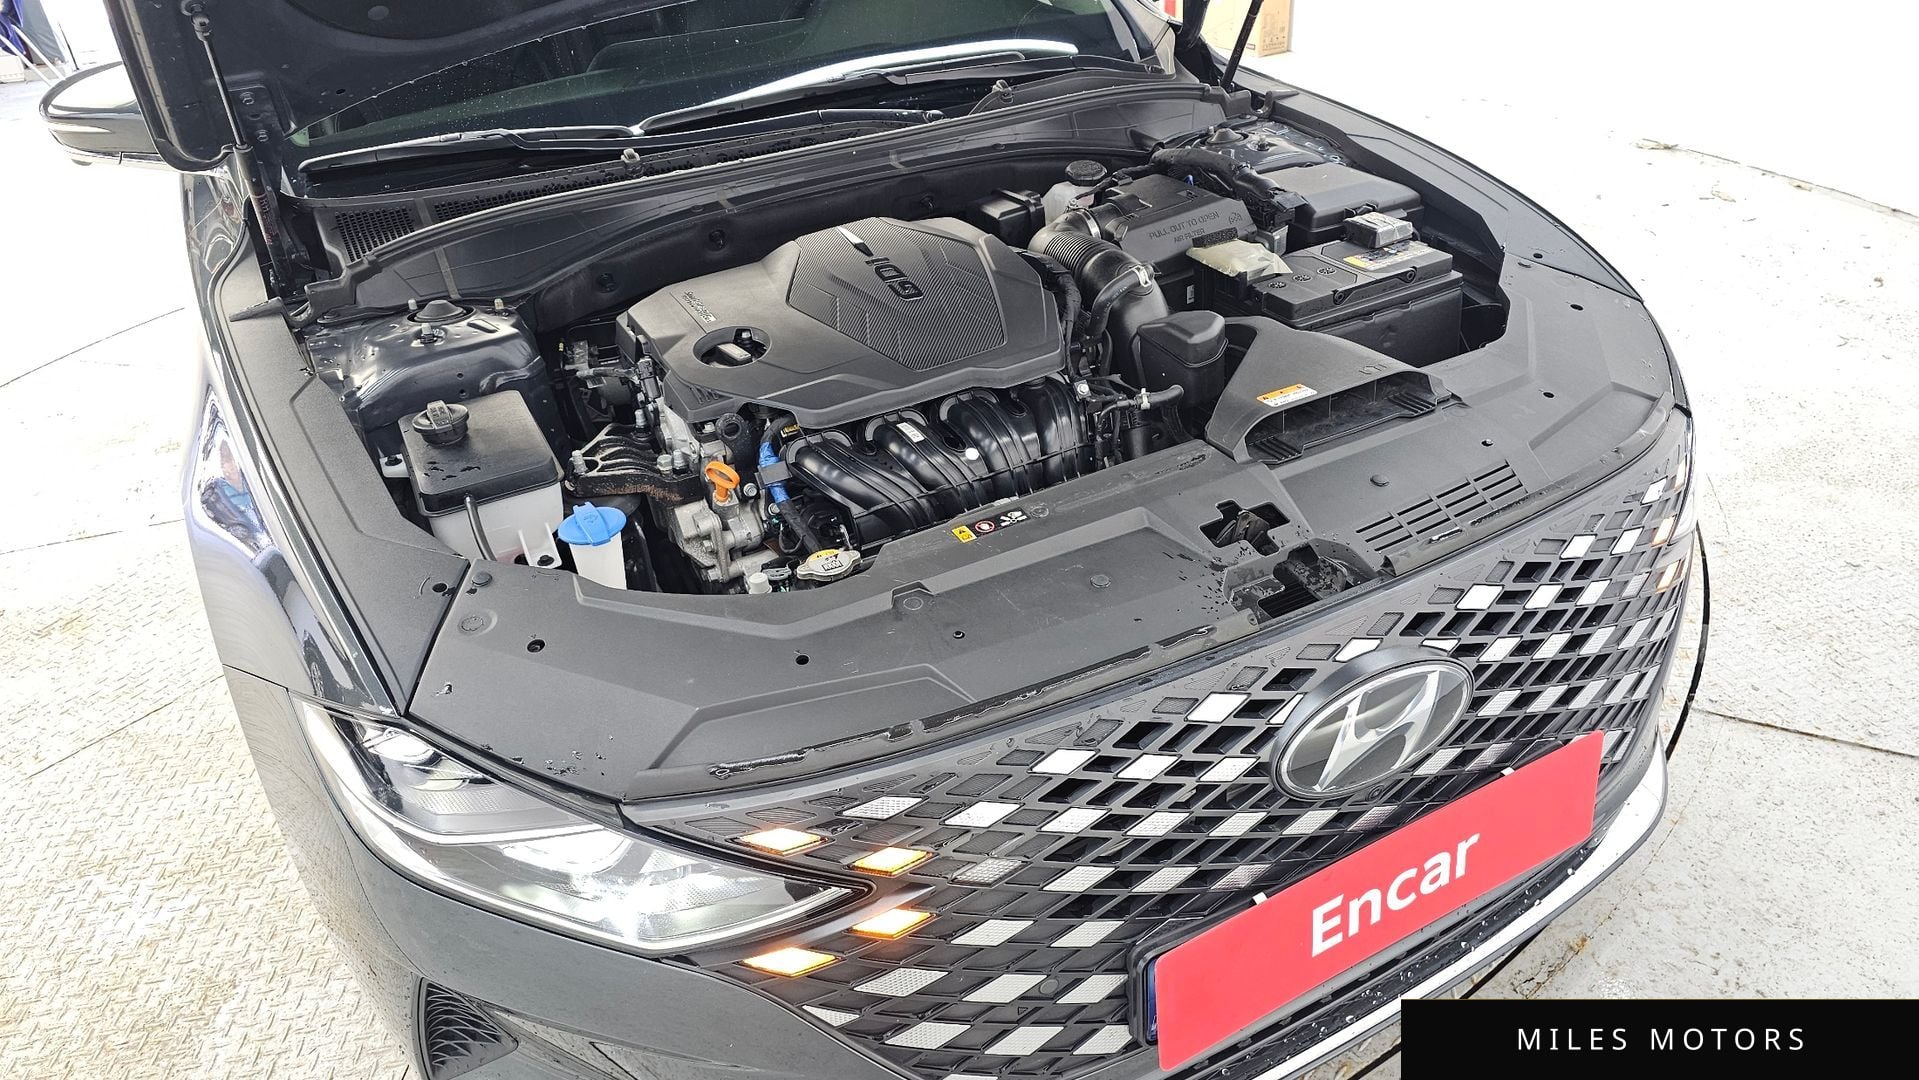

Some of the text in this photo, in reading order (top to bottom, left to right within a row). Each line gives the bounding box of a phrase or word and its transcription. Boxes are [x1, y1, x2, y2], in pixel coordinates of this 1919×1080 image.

[1149, 228, 1170, 240] PULL
[1170, 222, 1185, 233] OUT
[1187, 217, 1199, 228] TO
[1199, 211, 1220, 223] OPEN
[1184, 228, 1205, 239] FILTER
[1312, 833, 1480, 957] Encar
